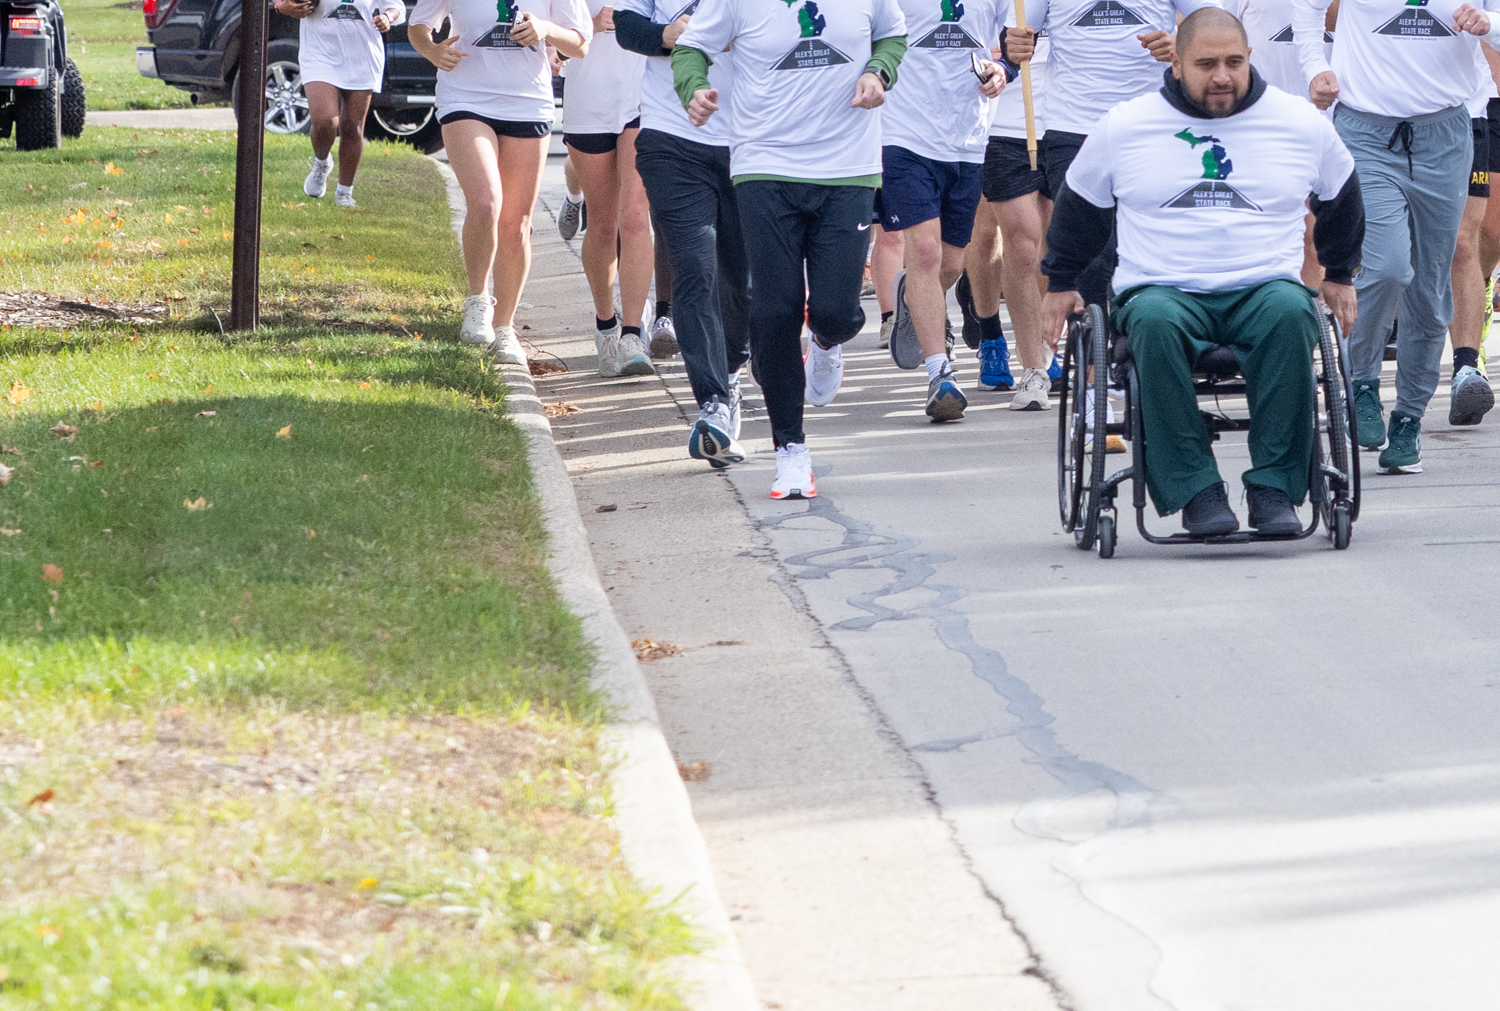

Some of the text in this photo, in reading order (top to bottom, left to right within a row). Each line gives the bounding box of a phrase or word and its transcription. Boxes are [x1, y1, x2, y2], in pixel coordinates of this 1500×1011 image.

[1398, 18, 1434, 26] ALEX'S GREAT
[1400, 27, 1431, 35] STATE RACE
[794, 48, 830, 59] ALEX'S GREAT
[797, 57, 829, 67] STATE RACE
[1193, 190, 1234, 199] ALEX'S GREAT
[1195, 199, 1232, 207] STATE RACE
